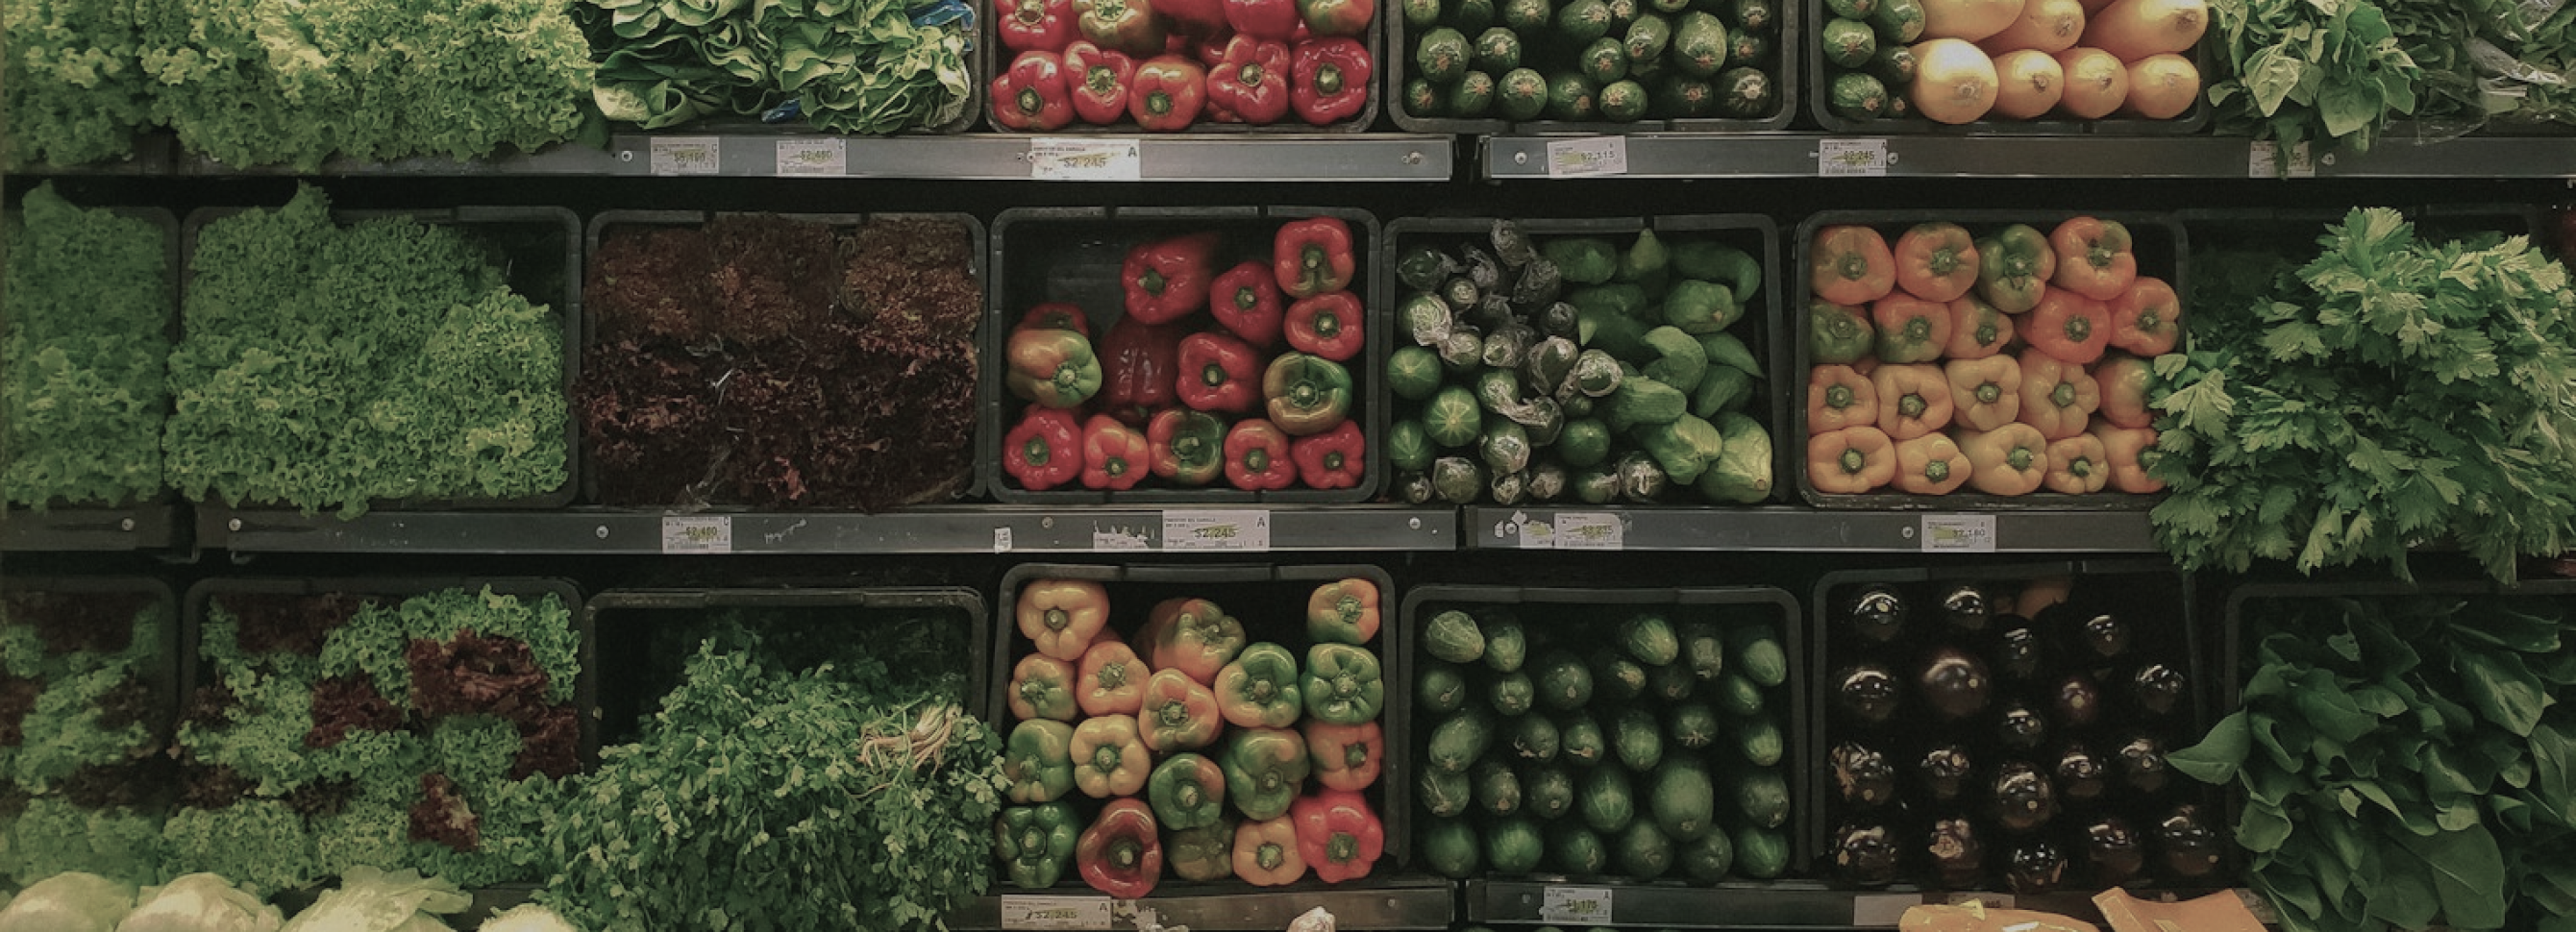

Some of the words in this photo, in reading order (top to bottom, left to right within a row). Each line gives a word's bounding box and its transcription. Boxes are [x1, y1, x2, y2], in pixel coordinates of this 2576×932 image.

[1127, 146, 1138, 159] A
[1256, 516, 1266, 527] A
[1099, 902, 1108, 912] A
